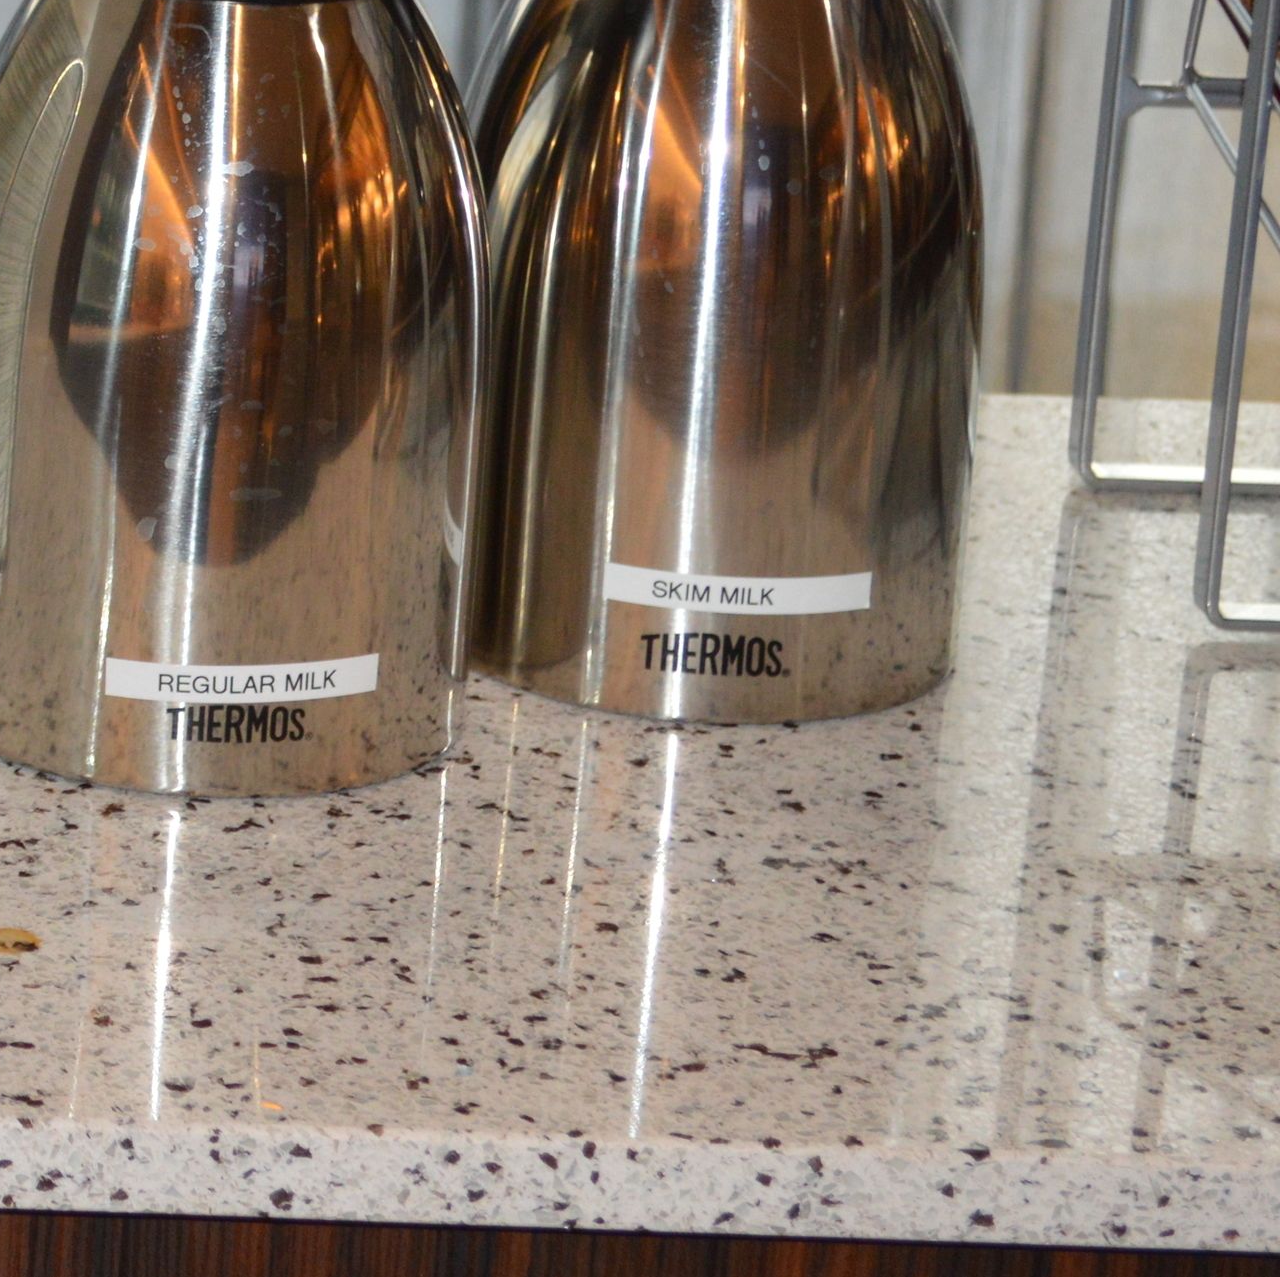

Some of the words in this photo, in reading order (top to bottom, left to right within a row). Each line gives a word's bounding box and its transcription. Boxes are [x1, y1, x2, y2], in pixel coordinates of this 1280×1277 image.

[651, 580, 711, 603] SKIM
[719, 586, 776, 606] MILK
[640, 633, 784, 678] THERMOS
[157, 673, 276, 695] REGULAR
[284, 669, 338, 693] MILK
[166, 704, 307, 743] THERMOS
